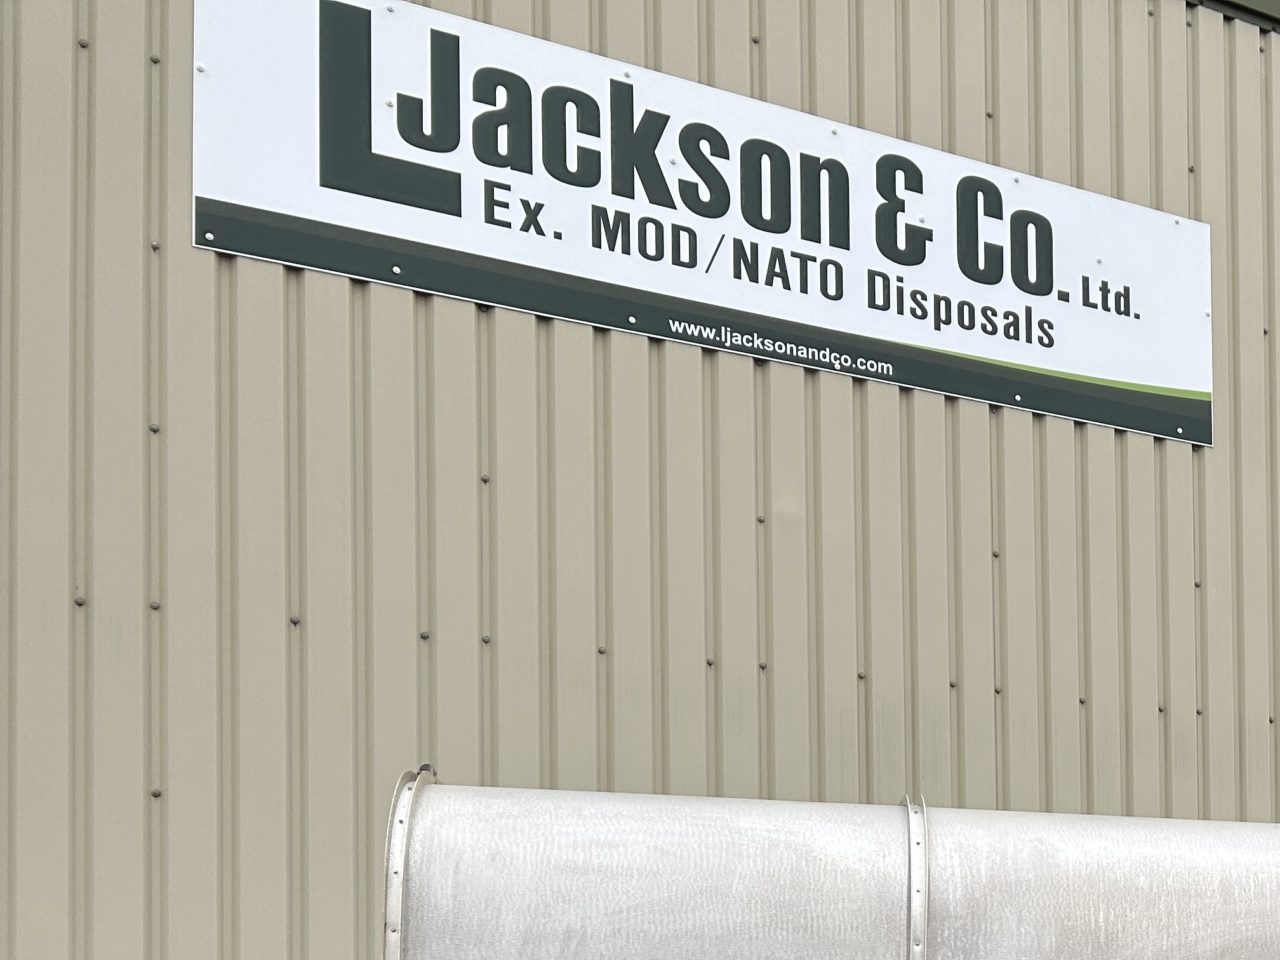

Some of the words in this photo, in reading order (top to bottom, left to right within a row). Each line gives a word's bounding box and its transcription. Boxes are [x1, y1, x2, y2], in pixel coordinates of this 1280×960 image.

[484, 179, 563, 240] Ex.
[591, 204, 844, 301] MOD/NATO
[867, 268, 1055, 349] Disposals
[875, 153, 933, 266] &
[956, 175, 1070, 303] Co.
[1081, 275, 1141, 320] Ltd.
[669, 318, 893, 376] www.ljacksonandco.com
